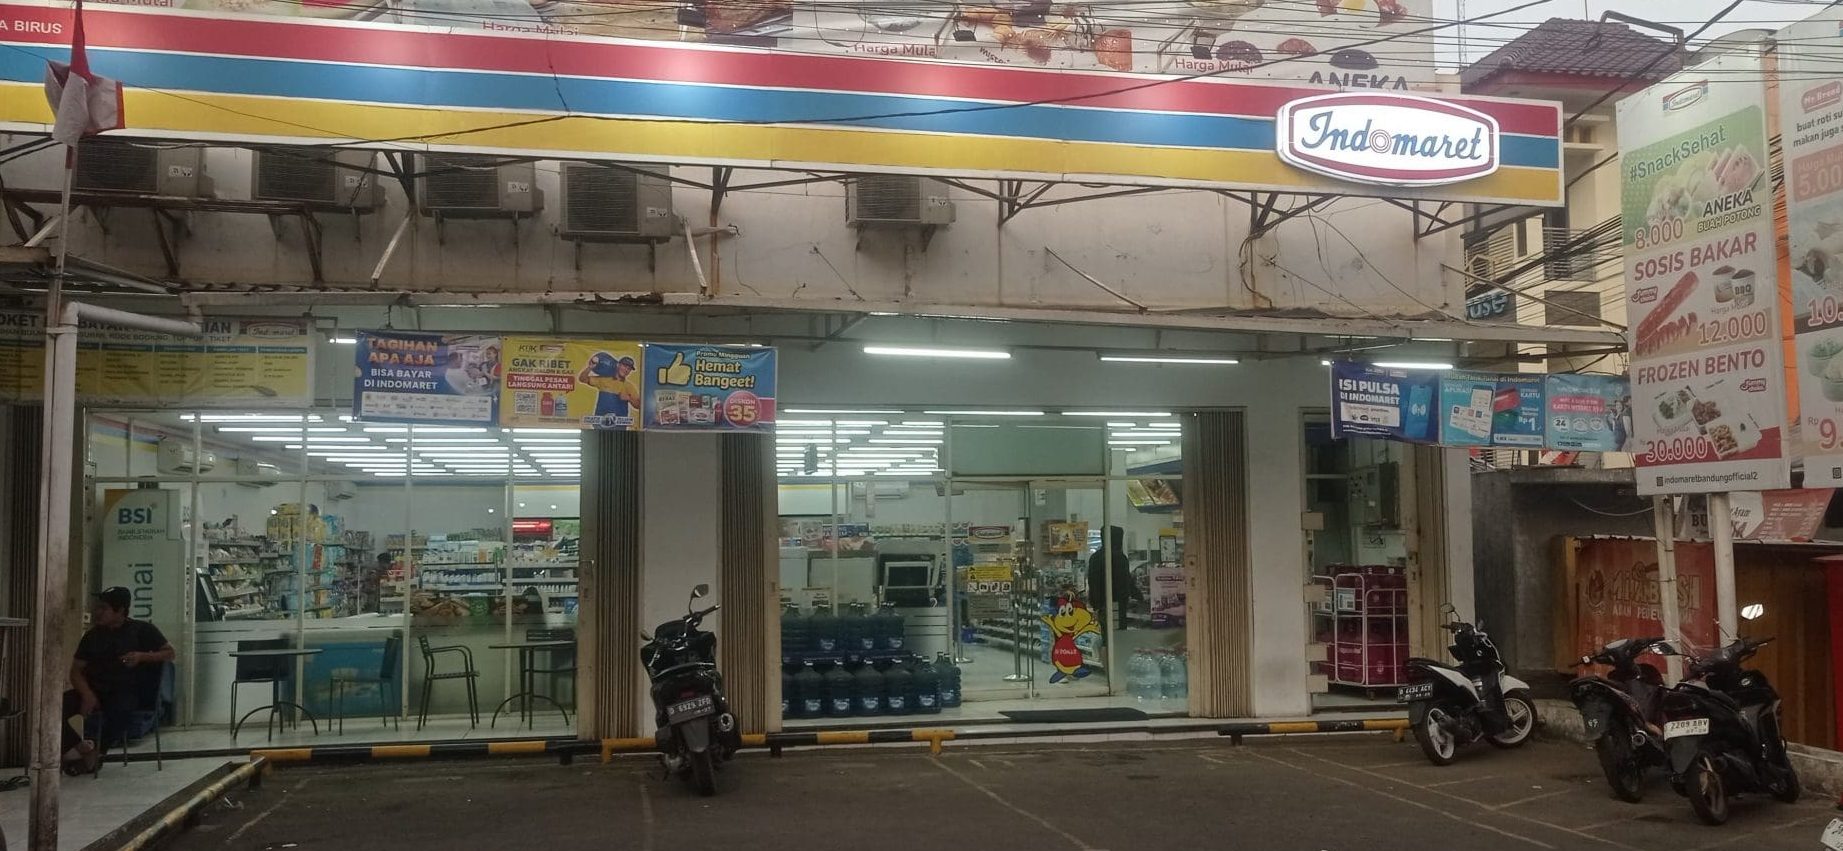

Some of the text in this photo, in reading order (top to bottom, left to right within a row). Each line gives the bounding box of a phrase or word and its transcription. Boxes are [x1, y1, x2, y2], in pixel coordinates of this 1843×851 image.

[14, 20, 63, 35] BIRUS
[1175, 58, 1215, 72] Harga
[1796, 118, 1815, 132] buat
[1817, 111, 1832, 125] roti
[1301, 110, 1482, 160] Indomaret
[1793, 127, 1840, 148] makan juga
[1629, 124, 1727, 183] #SnackSehat
[1702, 187, 1754, 219] ANEKA
[1696, 204, 1763, 234] BUAH POTONG
[1634, 217, 1685, 250] 8.000
[1633, 231, 1758, 282] SOSIS BAKAR
[1698, 311, 1767, 346] 12.000
[367, 336, 438, 352] TAGIHAN
[368, 351, 436, 366] APA AJA
[512, 357, 571, 369] GAK RIBET
[695, 359, 742, 373] Hemat
[1637, 348, 1766, 385] FROZEN BENTO
[371, 368, 432, 379] BISA BAYAR
[513, 375, 544, 383] TINGGAL
[694, 373, 756, 390] Bangeet!
[364, 379, 438, 390] DI INDOMARET
[508, 381, 547, 390] LANGSUNG
[1338, 378, 1400, 396] ISI PULSA
[1349, 393, 1400, 406] INDOMARET
[1555, 419, 1566, 427] 24
[1645, 435, 1708, 463] 30.000
[118, 507, 153, 525] BSI
